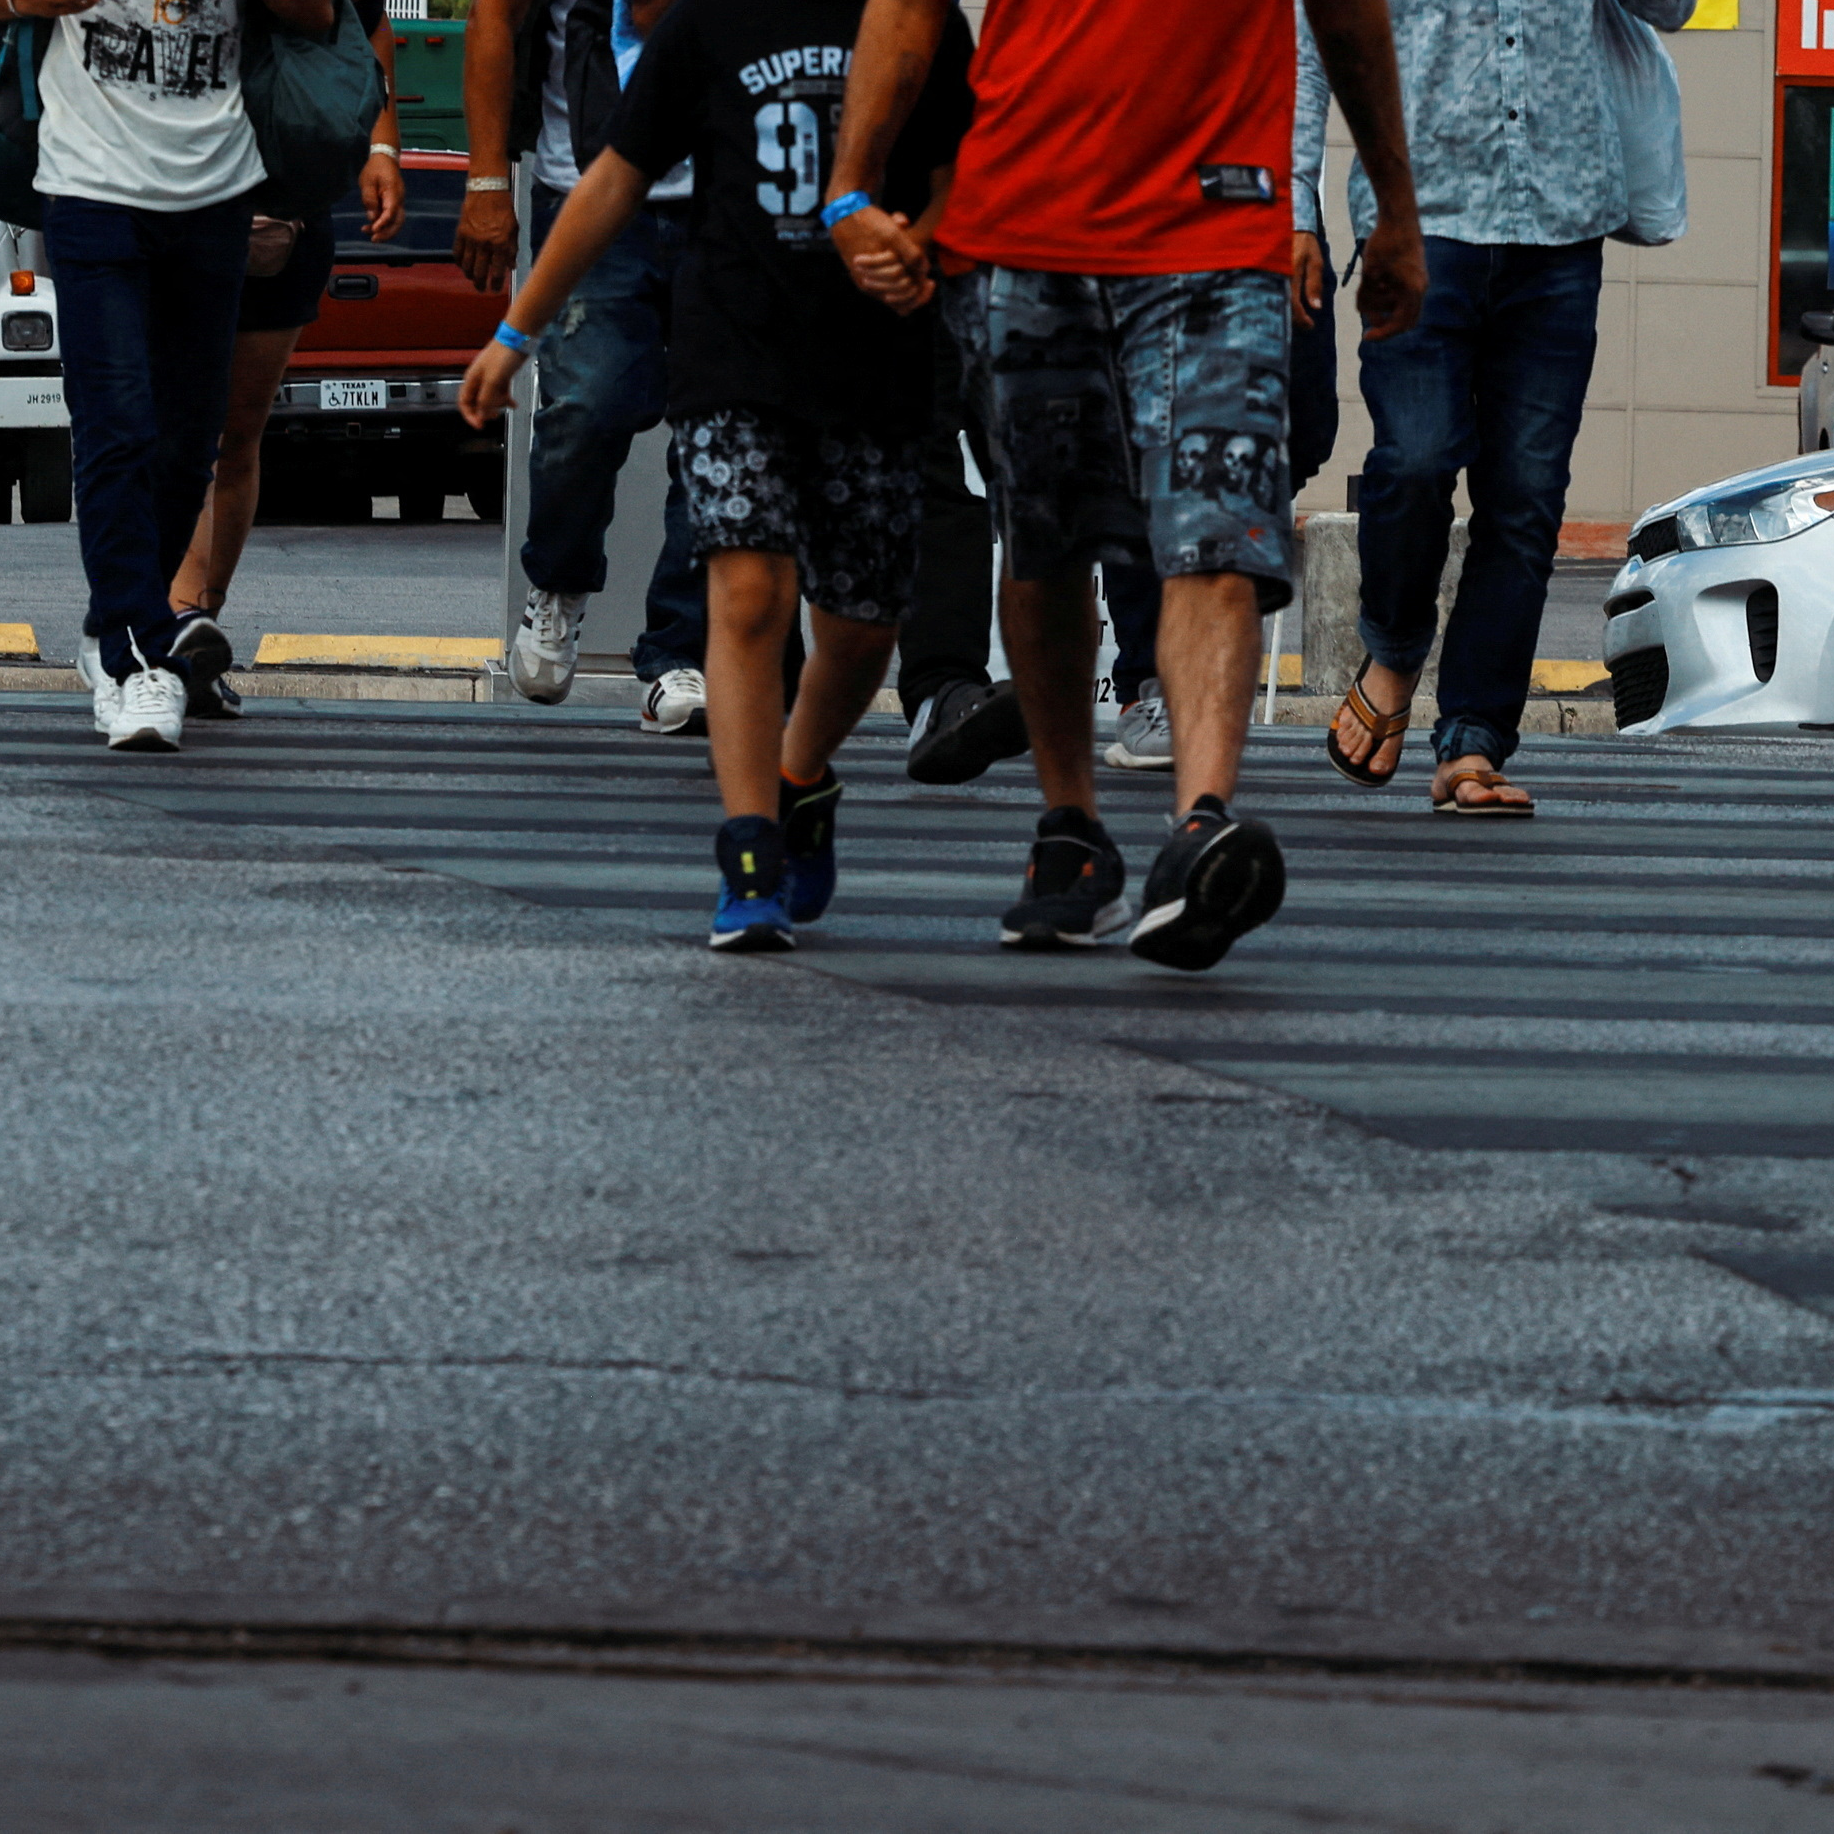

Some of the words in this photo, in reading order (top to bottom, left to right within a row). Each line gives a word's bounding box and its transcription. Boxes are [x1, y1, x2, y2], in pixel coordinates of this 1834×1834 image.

[341, 382, 367, 390] TEXAS
[26, 394, 39, 404] JH
[40, 393, 62, 404] 2919
